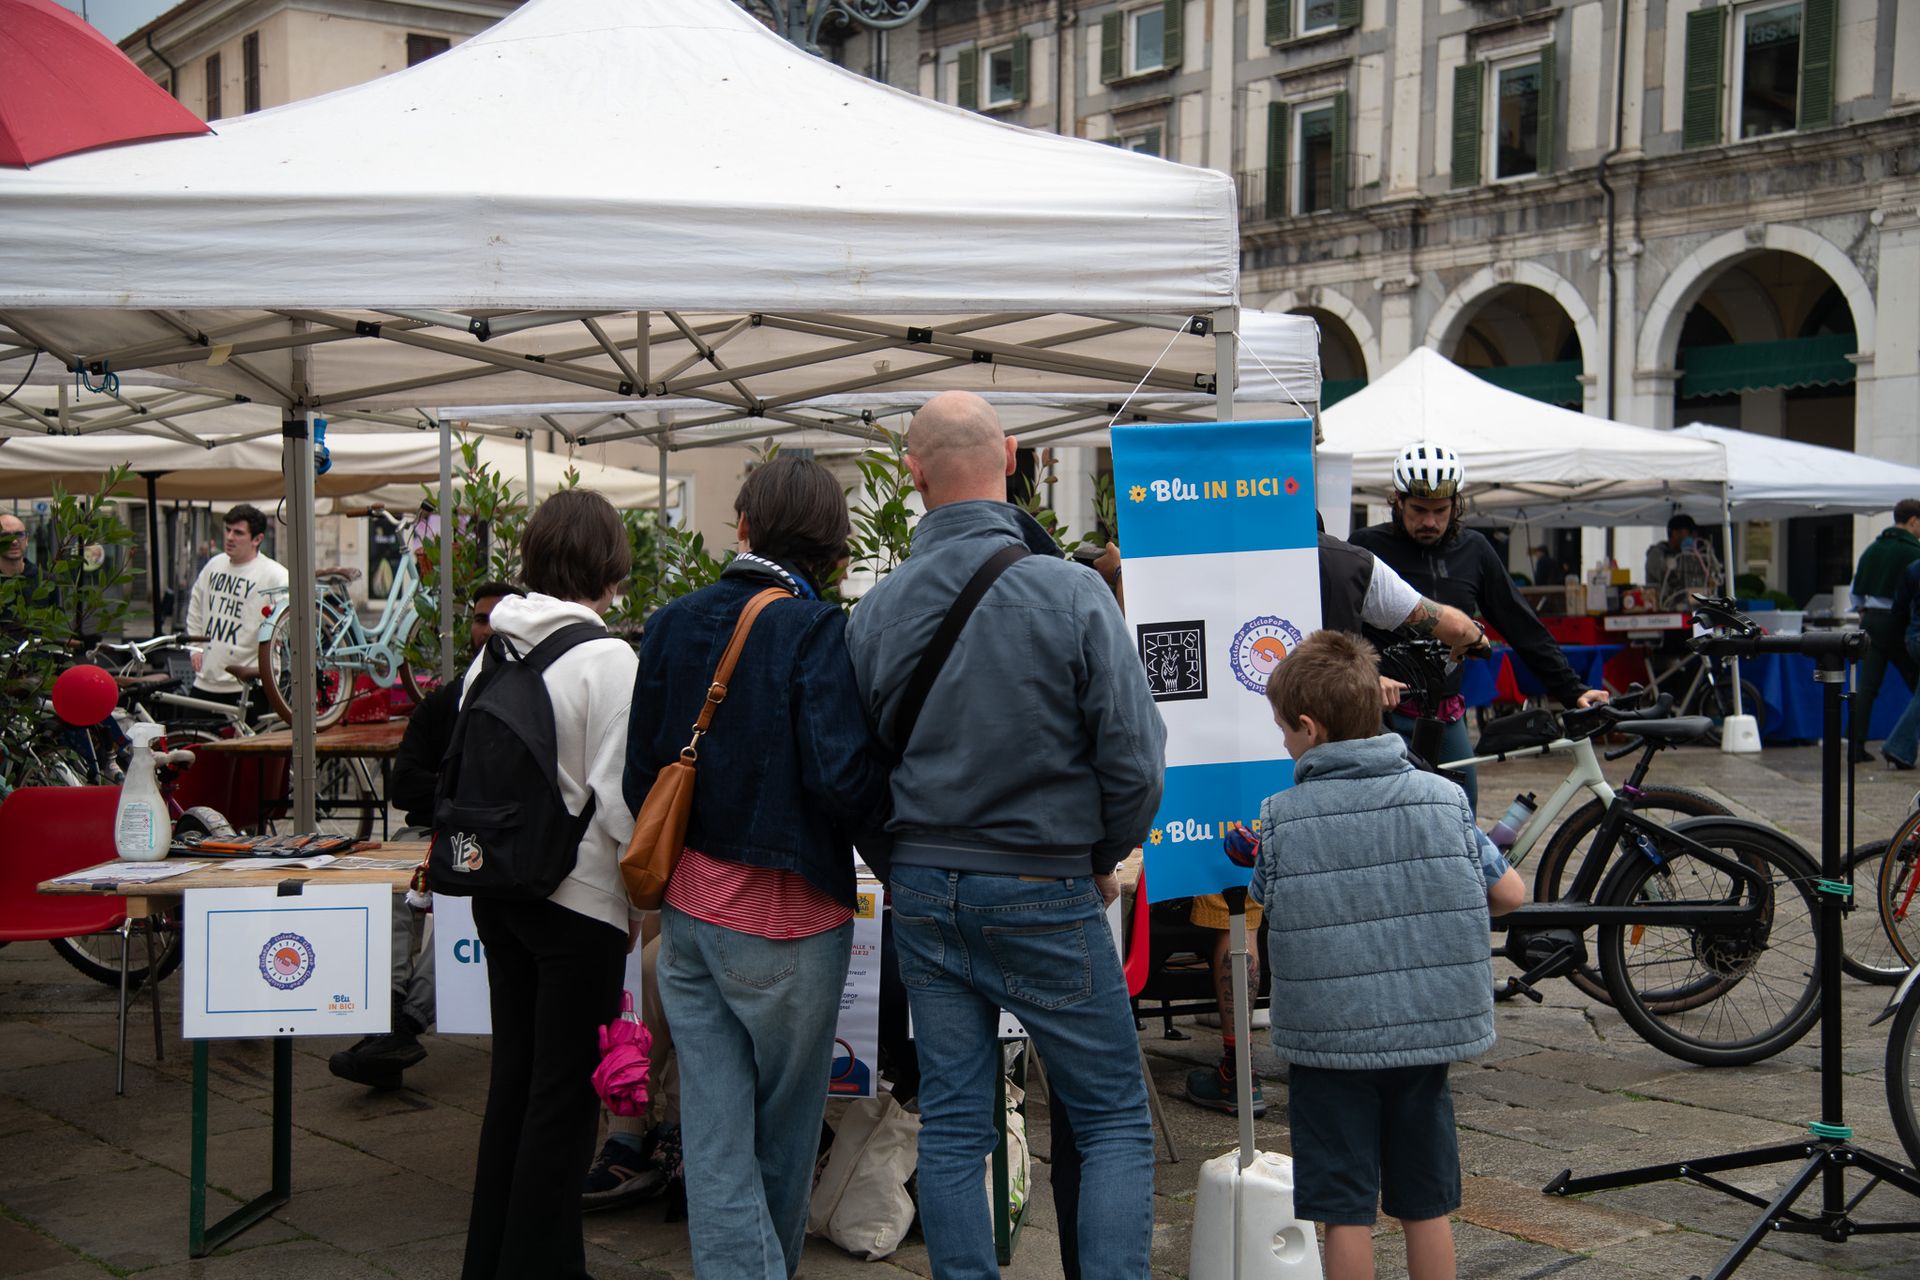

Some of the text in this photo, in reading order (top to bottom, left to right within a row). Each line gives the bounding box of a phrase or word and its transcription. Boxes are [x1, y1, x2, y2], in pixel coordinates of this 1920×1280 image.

[1150, 477, 1278, 501] Blu IN BICI
[219, 597, 244, 618] THE
[205, 616, 242, 645] ANK
[1166, 818, 1214, 842] Blu
[451, 832, 482, 867] YES
[454, 938, 487, 963] CI
[333, 994, 350, 1003] Blu
